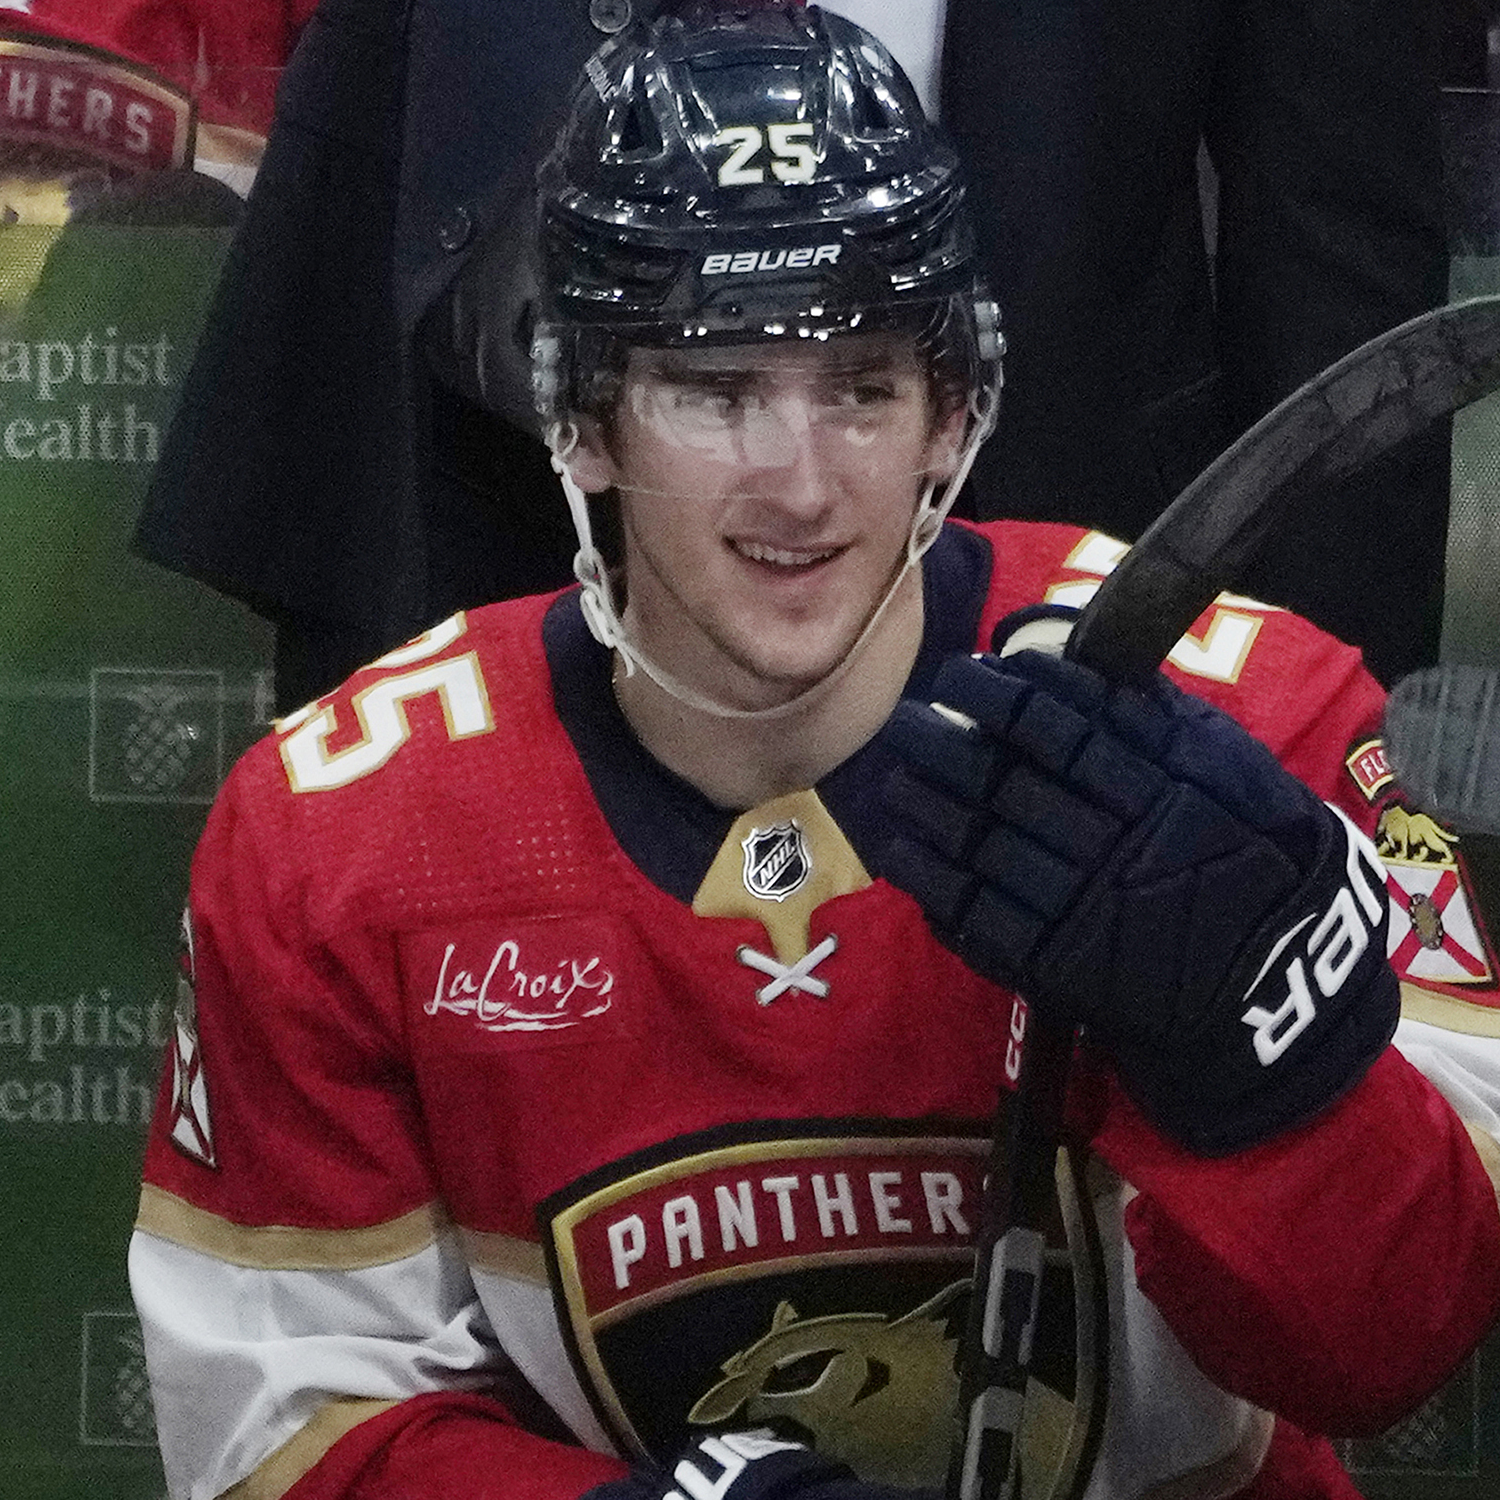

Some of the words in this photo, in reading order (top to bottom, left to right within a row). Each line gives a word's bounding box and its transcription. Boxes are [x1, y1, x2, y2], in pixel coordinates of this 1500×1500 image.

[712, 123, 818, 188] 25
[759, 840, 796, 887] NHL
[423, 940, 615, 1030] LaCroix
[607, 1166, 980, 1291] PANTHER
